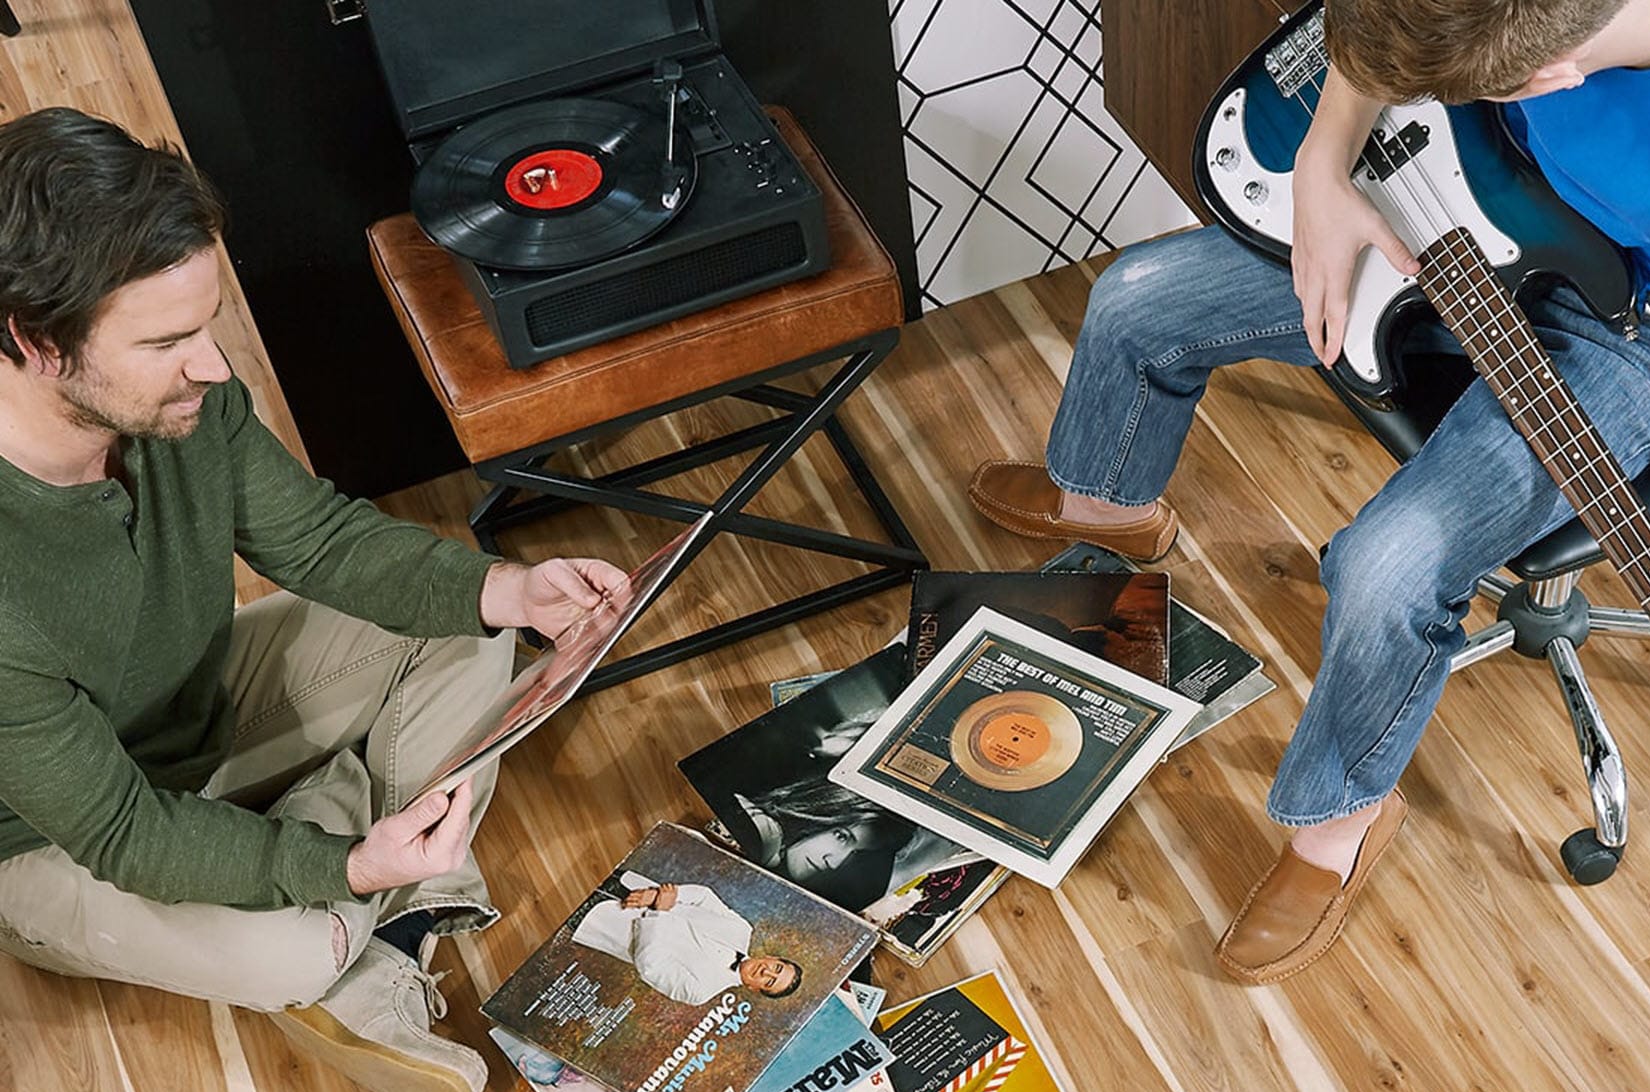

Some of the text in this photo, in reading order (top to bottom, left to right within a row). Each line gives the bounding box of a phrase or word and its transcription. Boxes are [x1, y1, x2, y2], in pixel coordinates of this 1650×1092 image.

[997, 653, 1019, 668] THE
[1016, 662, 1045, 679] BEST
[1042, 673, 1059, 685] OF
[1056, 679, 1081, 696] MEL
[1080, 690, 1105, 706] AND
[1104, 699, 1128, 716] TIM
[715, 1002, 751, 1036] Mr.
[964, 1033, 999, 1056] Music
